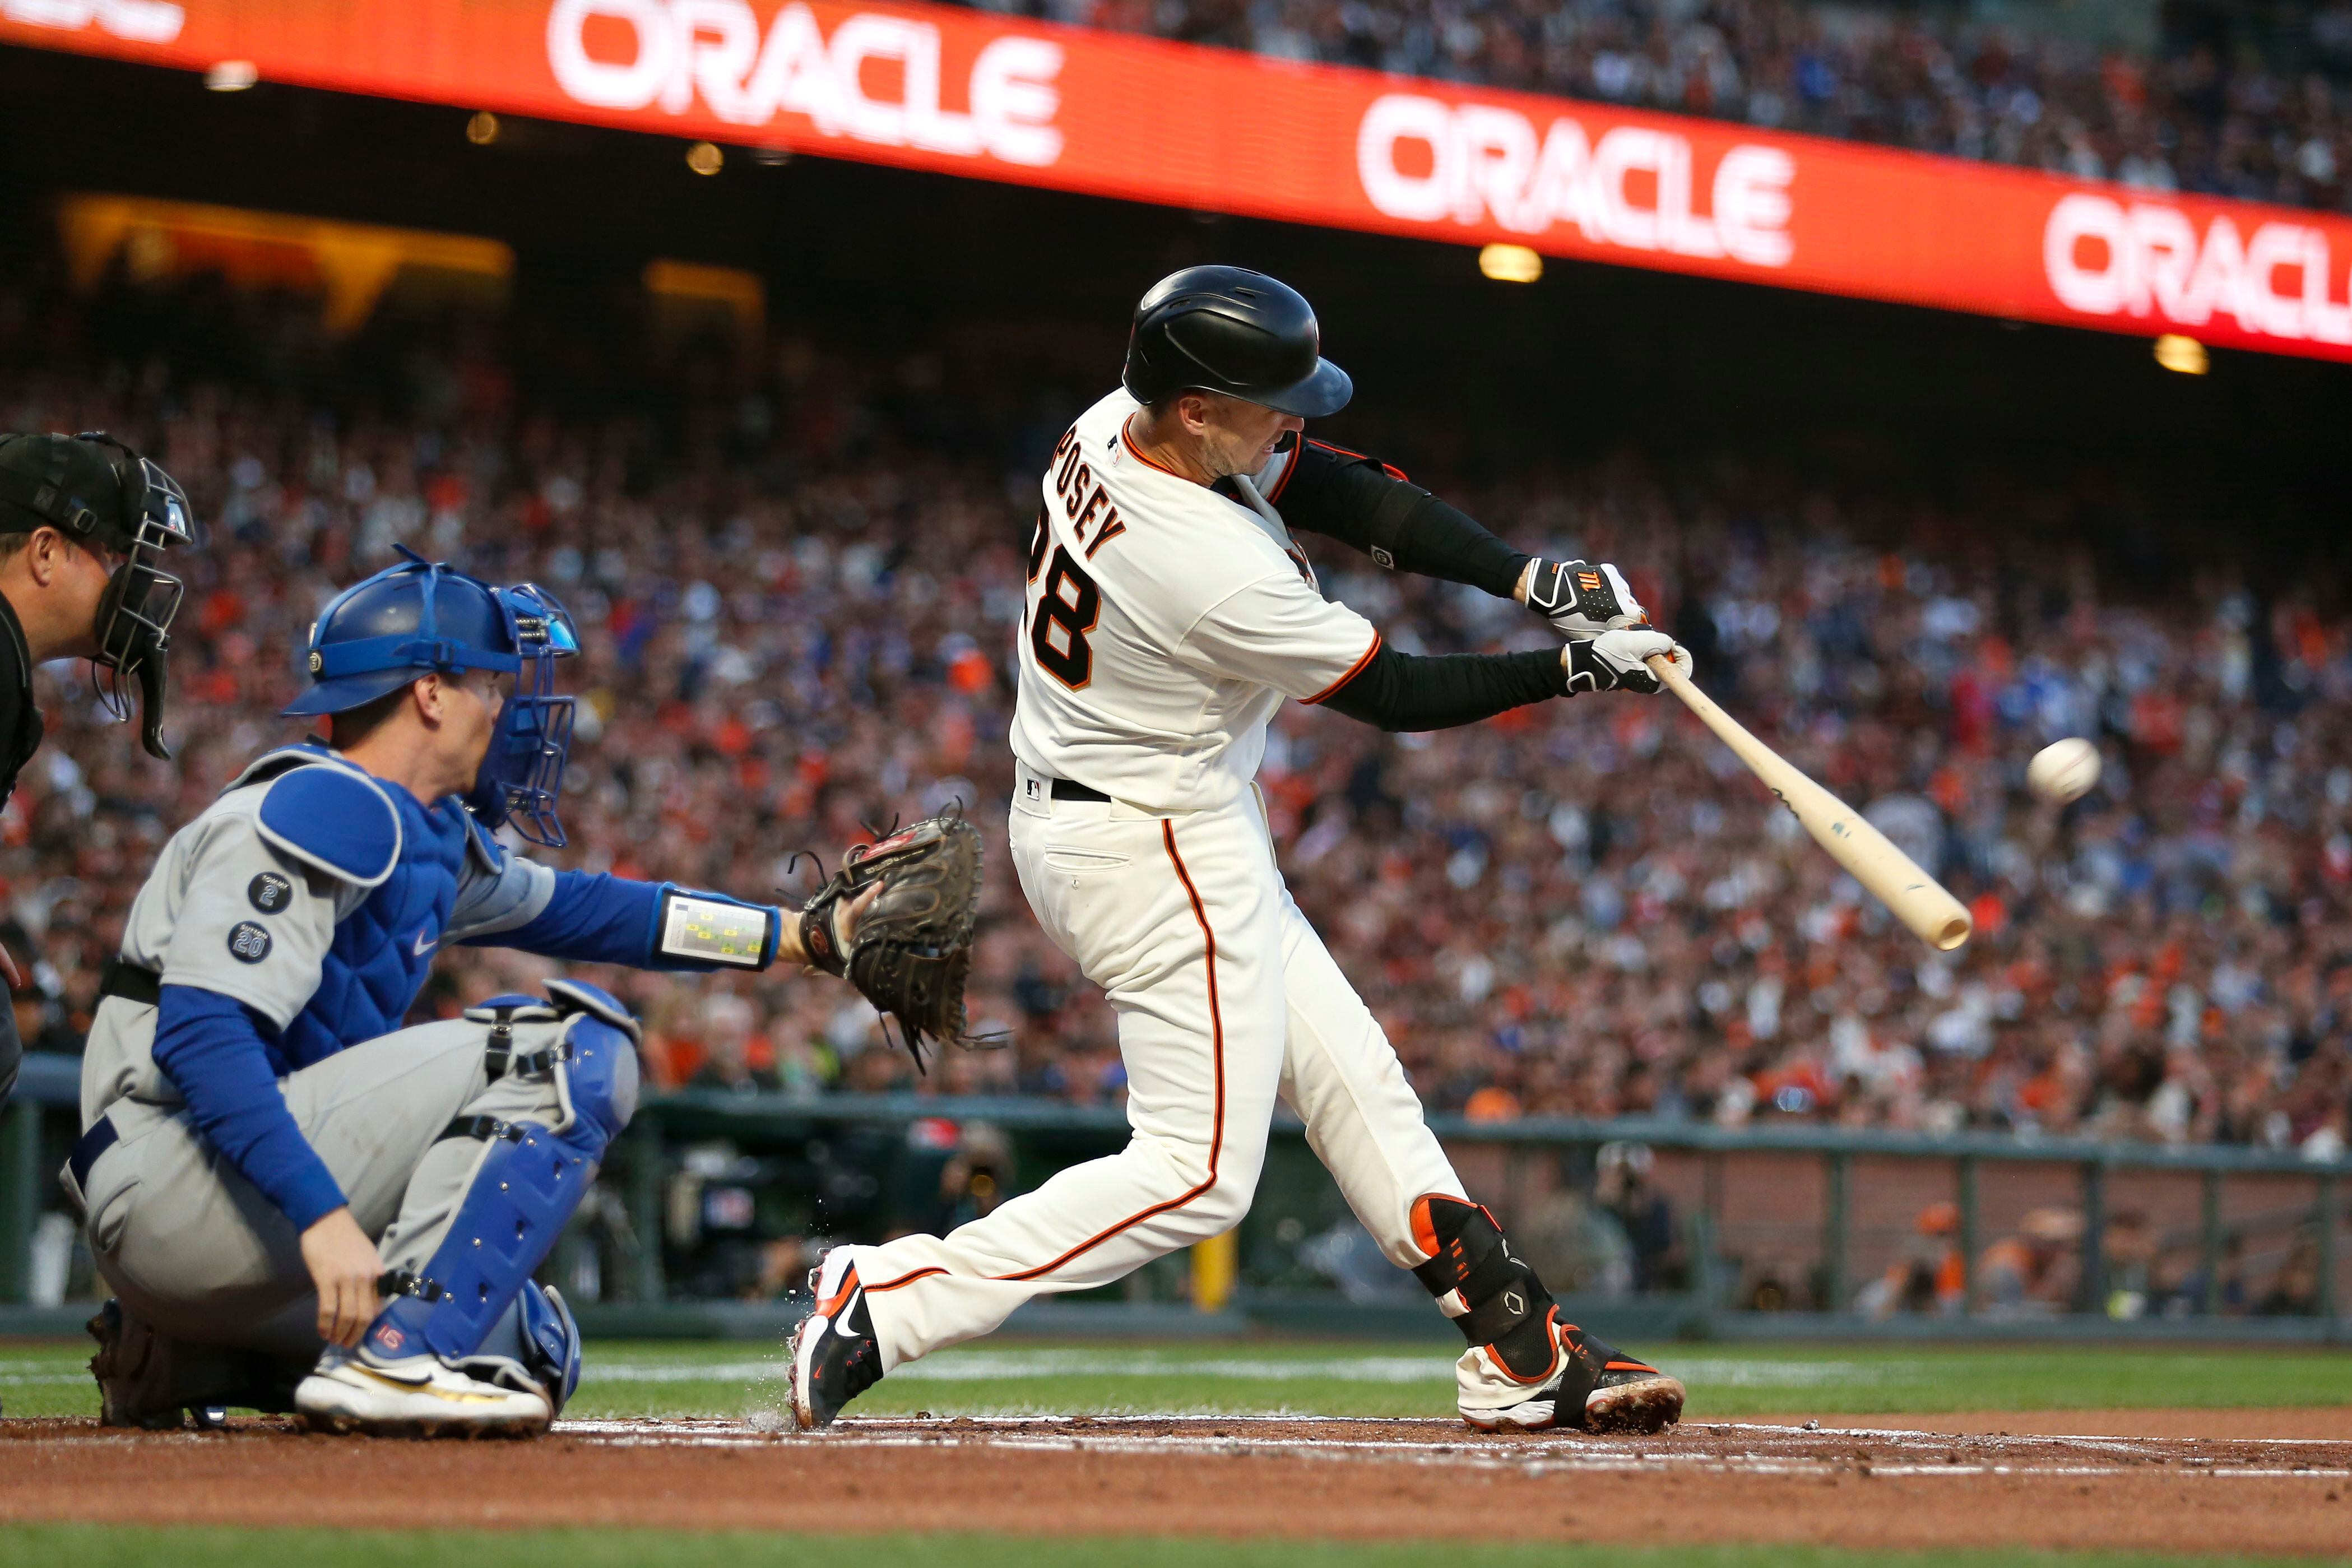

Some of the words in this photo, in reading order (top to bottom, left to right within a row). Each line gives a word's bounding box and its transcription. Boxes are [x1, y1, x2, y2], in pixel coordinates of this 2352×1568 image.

[545, 0, 1066, 167] ORACLE
[1356, 93, 1796, 268] ORACLE
[2042, 193, 2352, 346] ORACL
[1050, 424, 1126, 562] POSEY
[233, 931, 266, 957] 20
[259, 884, 279, 907] 2
[376, 1323, 405, 1351] 16
